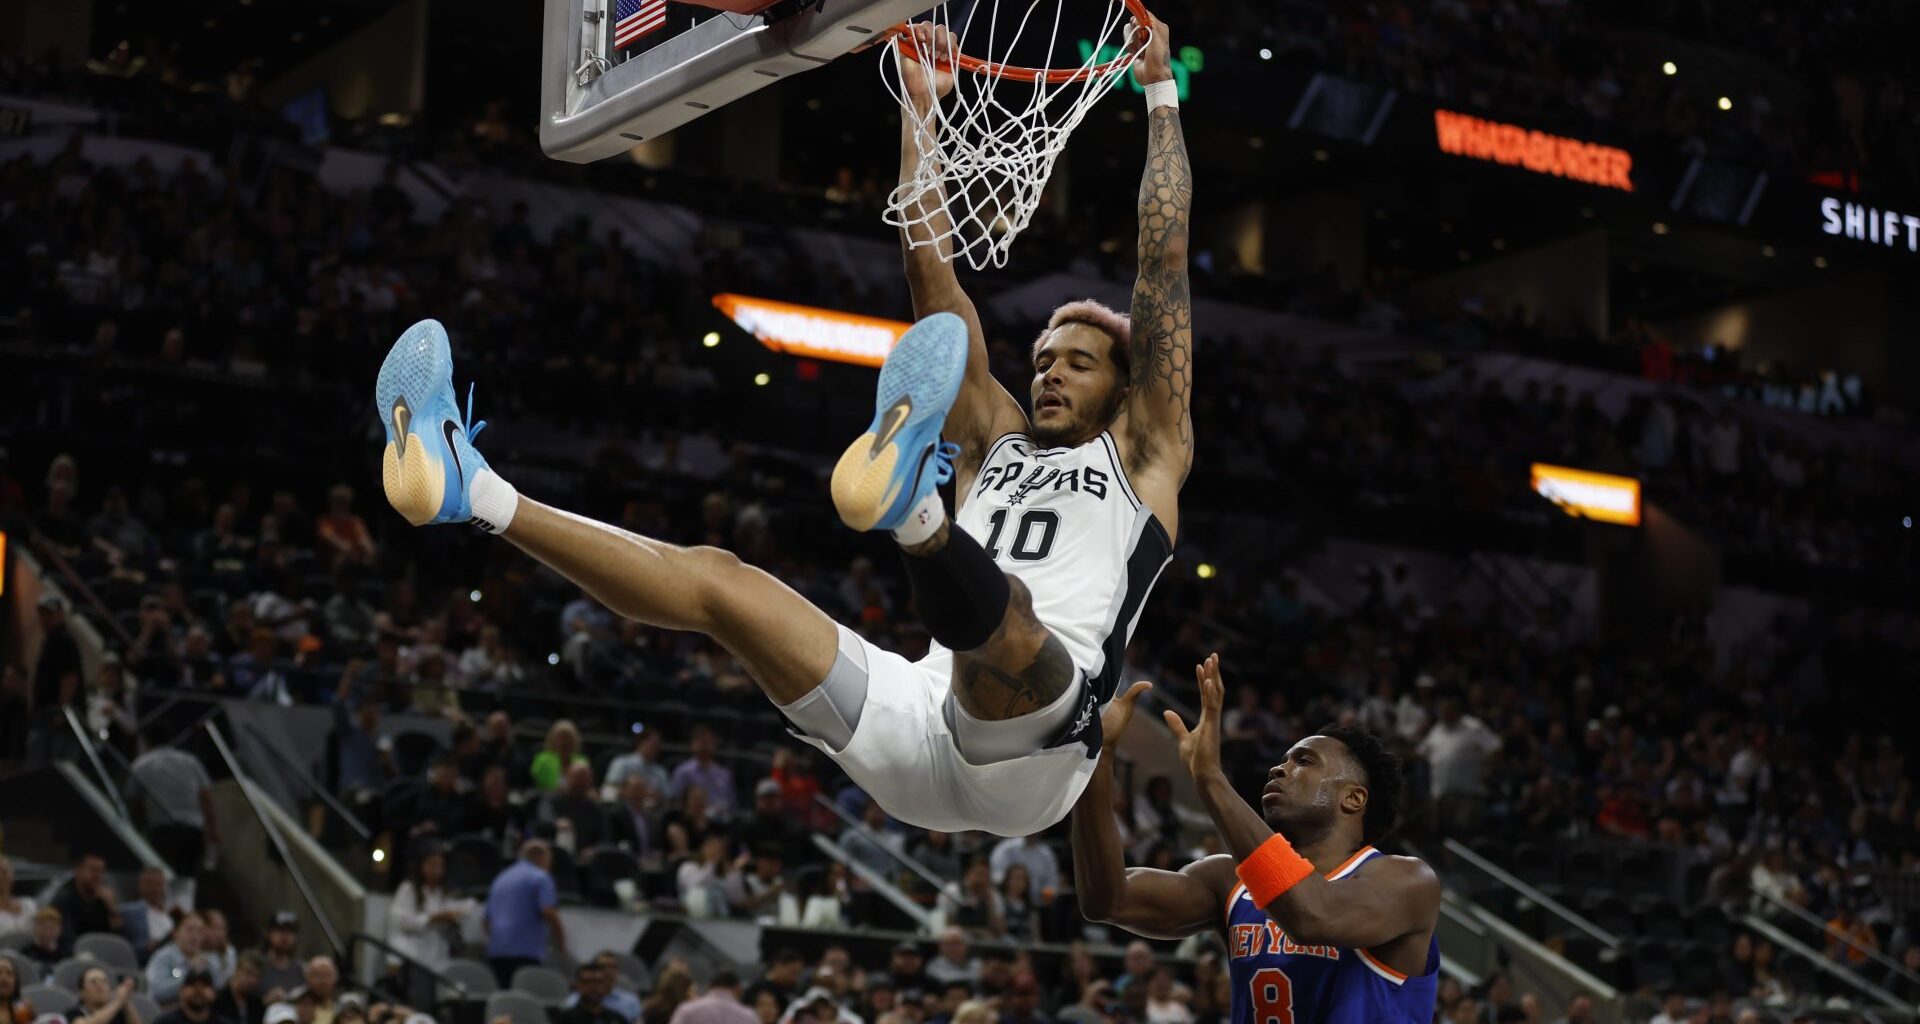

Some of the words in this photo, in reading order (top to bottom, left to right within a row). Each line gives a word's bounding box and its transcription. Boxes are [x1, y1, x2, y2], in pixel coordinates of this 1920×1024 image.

[1435, 109, 1634, 191] WHATABURGER
[1821, 197, 1920, 252] SHIFT
[977, 462, 1108, 503] SPURS
[984, 507, 1061, 563] 10
[1249, 967, 1295, 1024] 8
